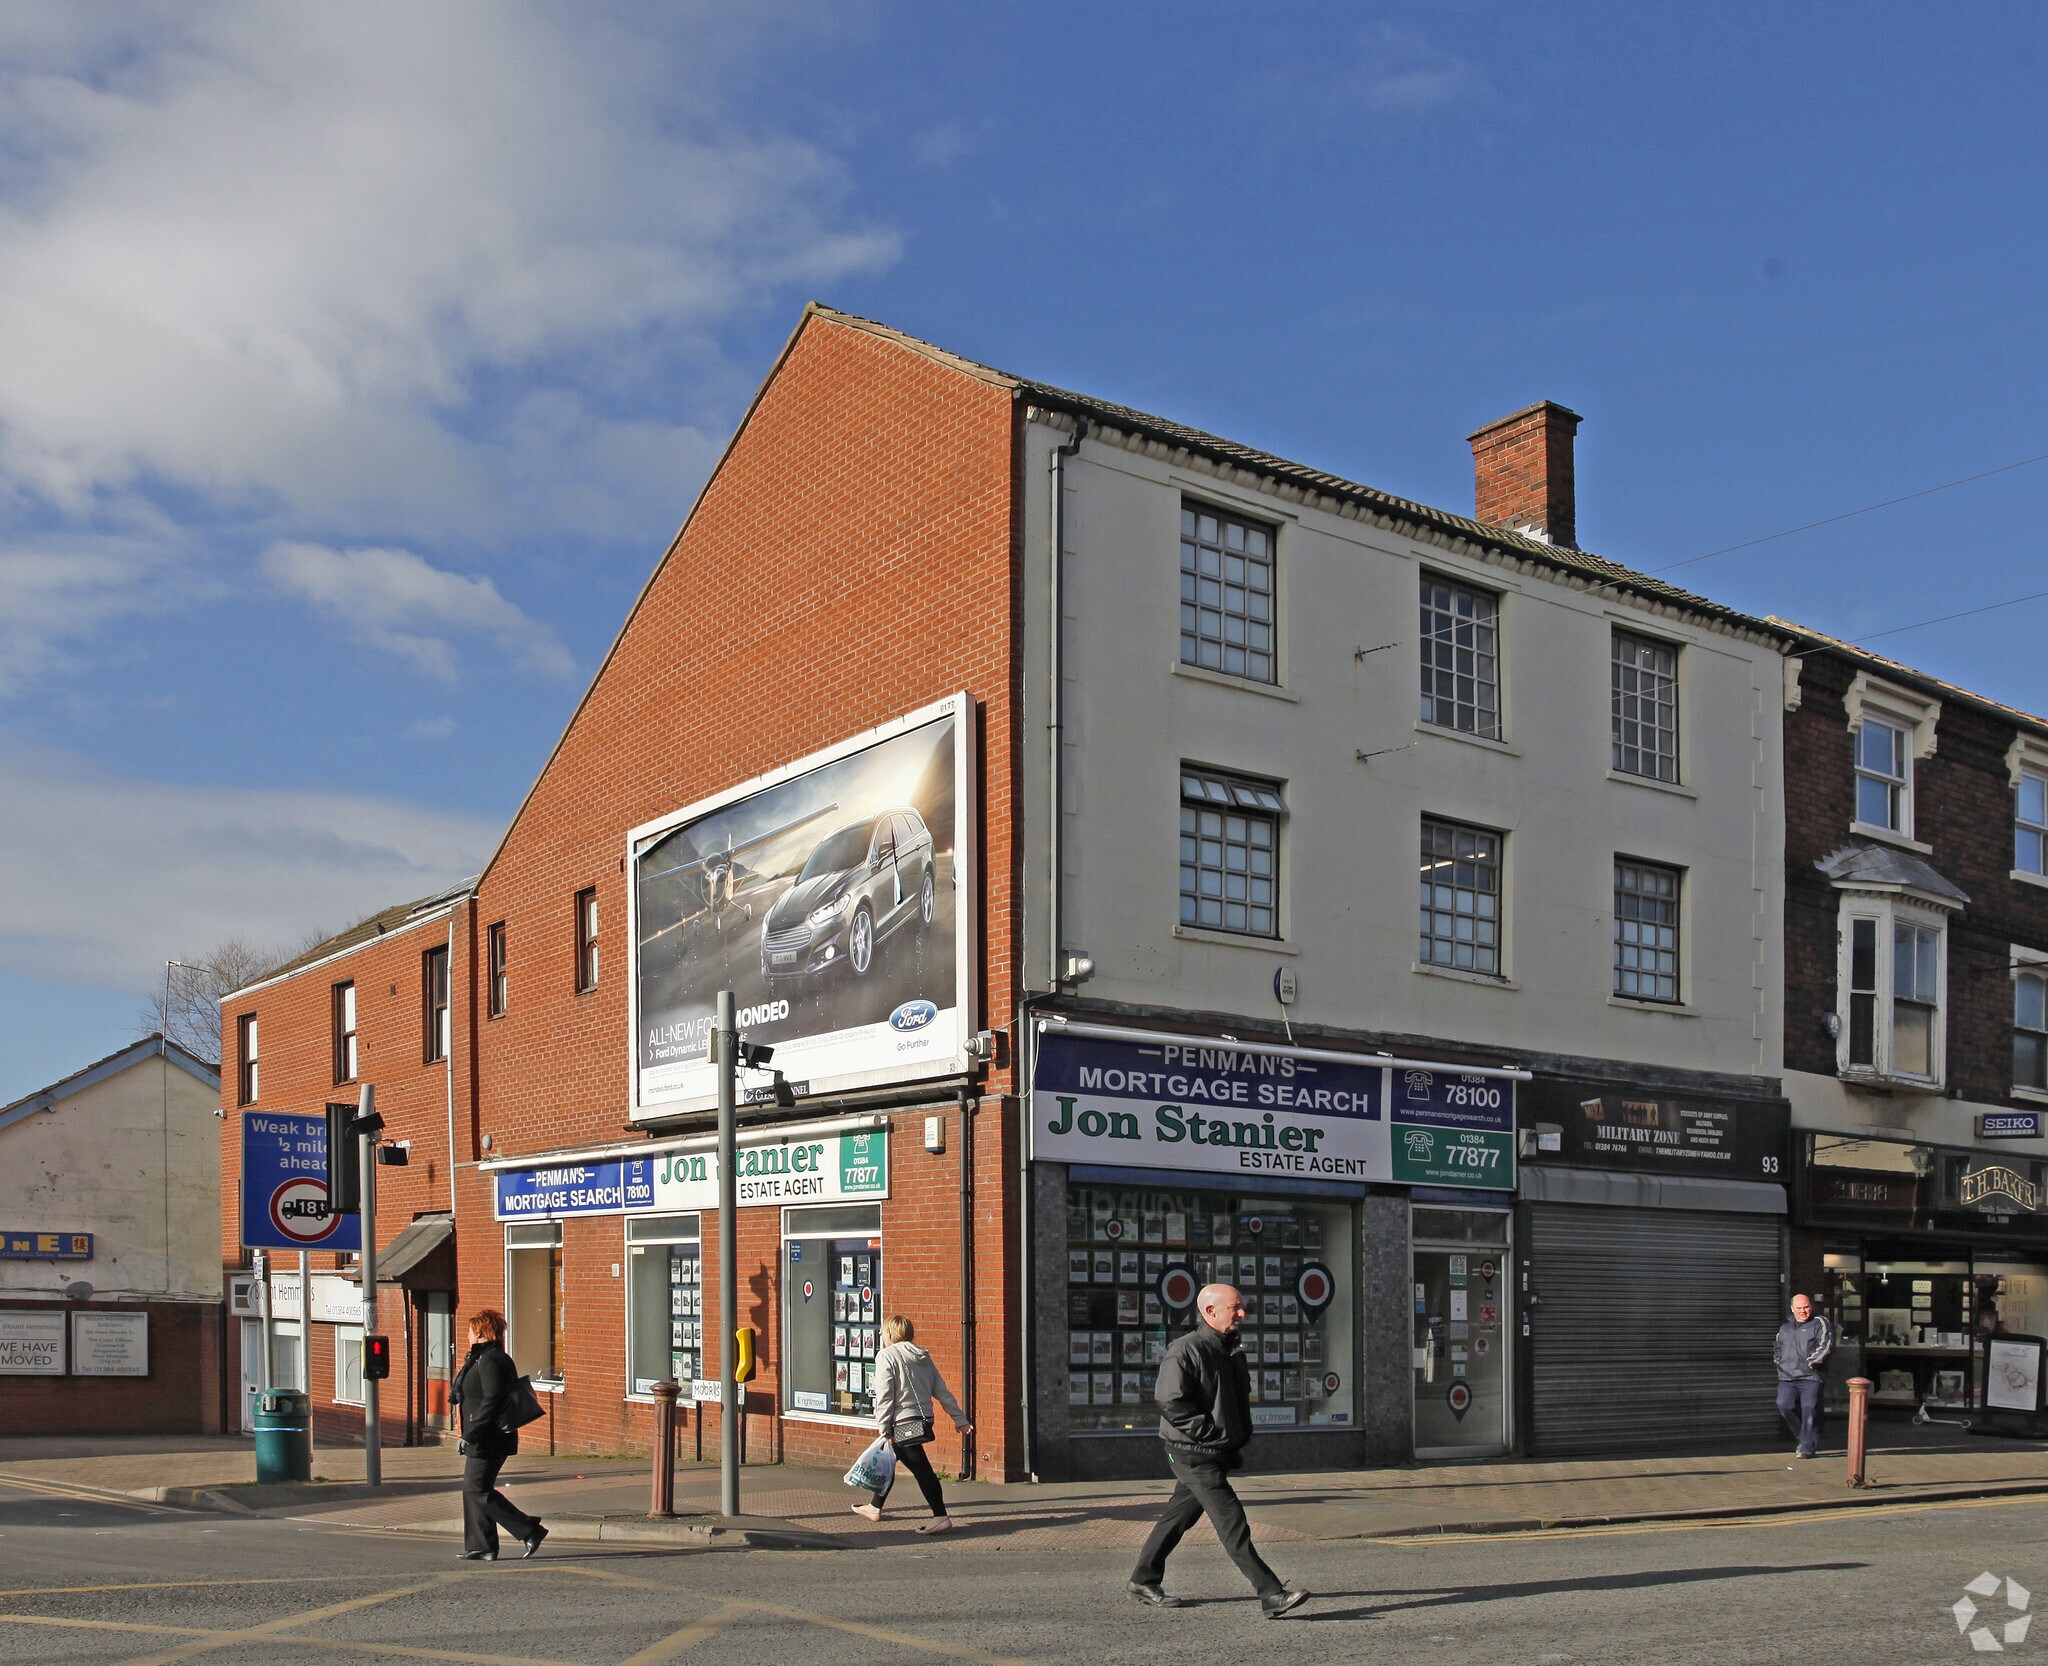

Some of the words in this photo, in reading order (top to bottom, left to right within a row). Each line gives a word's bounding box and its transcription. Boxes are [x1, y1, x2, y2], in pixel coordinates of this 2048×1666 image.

[897, 1005, 929, 1028] Ford
[649, 1020, 697, 1047] ALL-NEW
[655, 1046, 670, 1060] Ford
[670, 1041, 697, 1058] Dynamic
[896, 1039, 907, 1051] Go
[906, 1036, 930, 1049] Further
[1164, 1045, 1296, 1077] PENMAN'S
[1079, 1066, 1248, 1103] MORTGAGE
[1258, 1083, 1369, 1113] SEARCH
[1445, 1084, 1501, 1109] 78100
[252, 1119, 300, 1135] Weak
[1048, 1096, 1142, 1140] Jon
[1155, 1104, 1325, 1153] Stanier
[1984, 1117, 2034, 1129] SEIKO
[1460, 1134, 1485, 1145] 01384
[1597, 1125, 1651, 1143] MILITARY
[1653, 1129, 1680, 1145] ZONE
[661, 1149, 708, 1185] Jon
[716, 1136, 824, 1178] tanier
[853, 1156, 869, 1165] 01384
[1239, 1151, 1305, 1172] ESTATE
[1309, 1156, 1367, 1176] AGENT
[1446, 1145, 1501, 1168] 77877
[1762, 1156, 1779, 1174] 93
[535, 1167, 586, 1189] PENMAN'S
[844, 1165, 880, 1184] 77877
[1425, 1167, 1483, 1180] www.jonstanier.co.uk
[626, 1184, 650, 1200] 78100
[740, 1179, 782, 1200] ESTATE
[784, 1176, 824, 1197] AGENT
[1977, 1176, 1991, 1196] H.
[1993, 1169, 2033, 1207] BAKER
[299, 1201, 317, 1215] 18
[505, 1189, 569, 1212] MORTGAGE
[570, 1186, 621, 1208] SEARCH
[0, 1342, 18, 1353] WE
[22, 1342, 58, 1353] HAVE
[1, 1355, 52, 1366] MOVED
[802, 1396, 825, 1408] rightmove
[1255, 1412, 1293, 1424] rightmove
